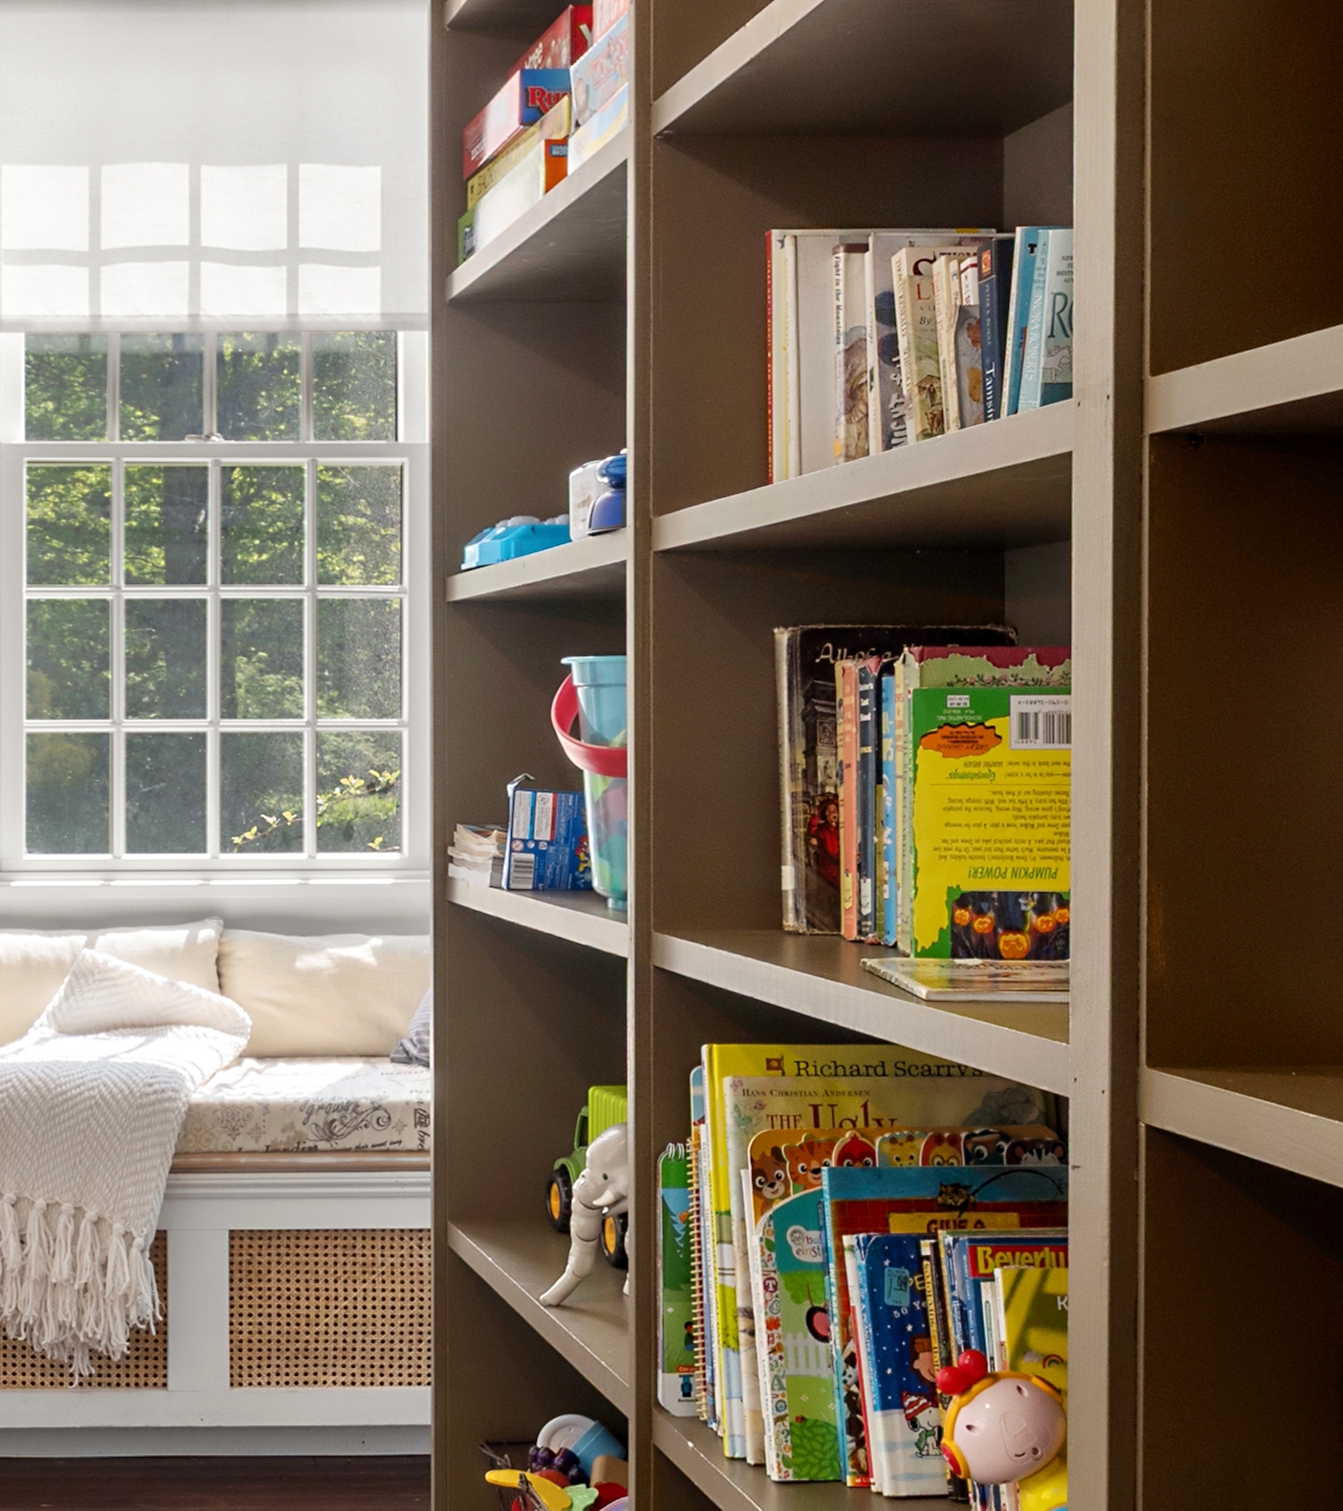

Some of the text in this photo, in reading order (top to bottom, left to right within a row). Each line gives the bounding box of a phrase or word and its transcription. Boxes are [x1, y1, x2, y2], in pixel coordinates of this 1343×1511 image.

[834, 256, 842, 277] Fight
[836, 279, 841, 287] in
[934, 272, 943, 317] Natural
[1025, 294, 1043, 381] NORA ROBERTS
[948, 769, 996, 783] Goosebumps
[968, 867, 1058, 879] PUMPKIN POWER!
[794, 1060, 983, 1077] Richard Scarry's
[742, 1089, 870, 1097] HANS CHRISTIAN ANDERSEN
[766, 1100, 898, 1129] THE Ugly
[893, 1307, 909, 1318] 50
